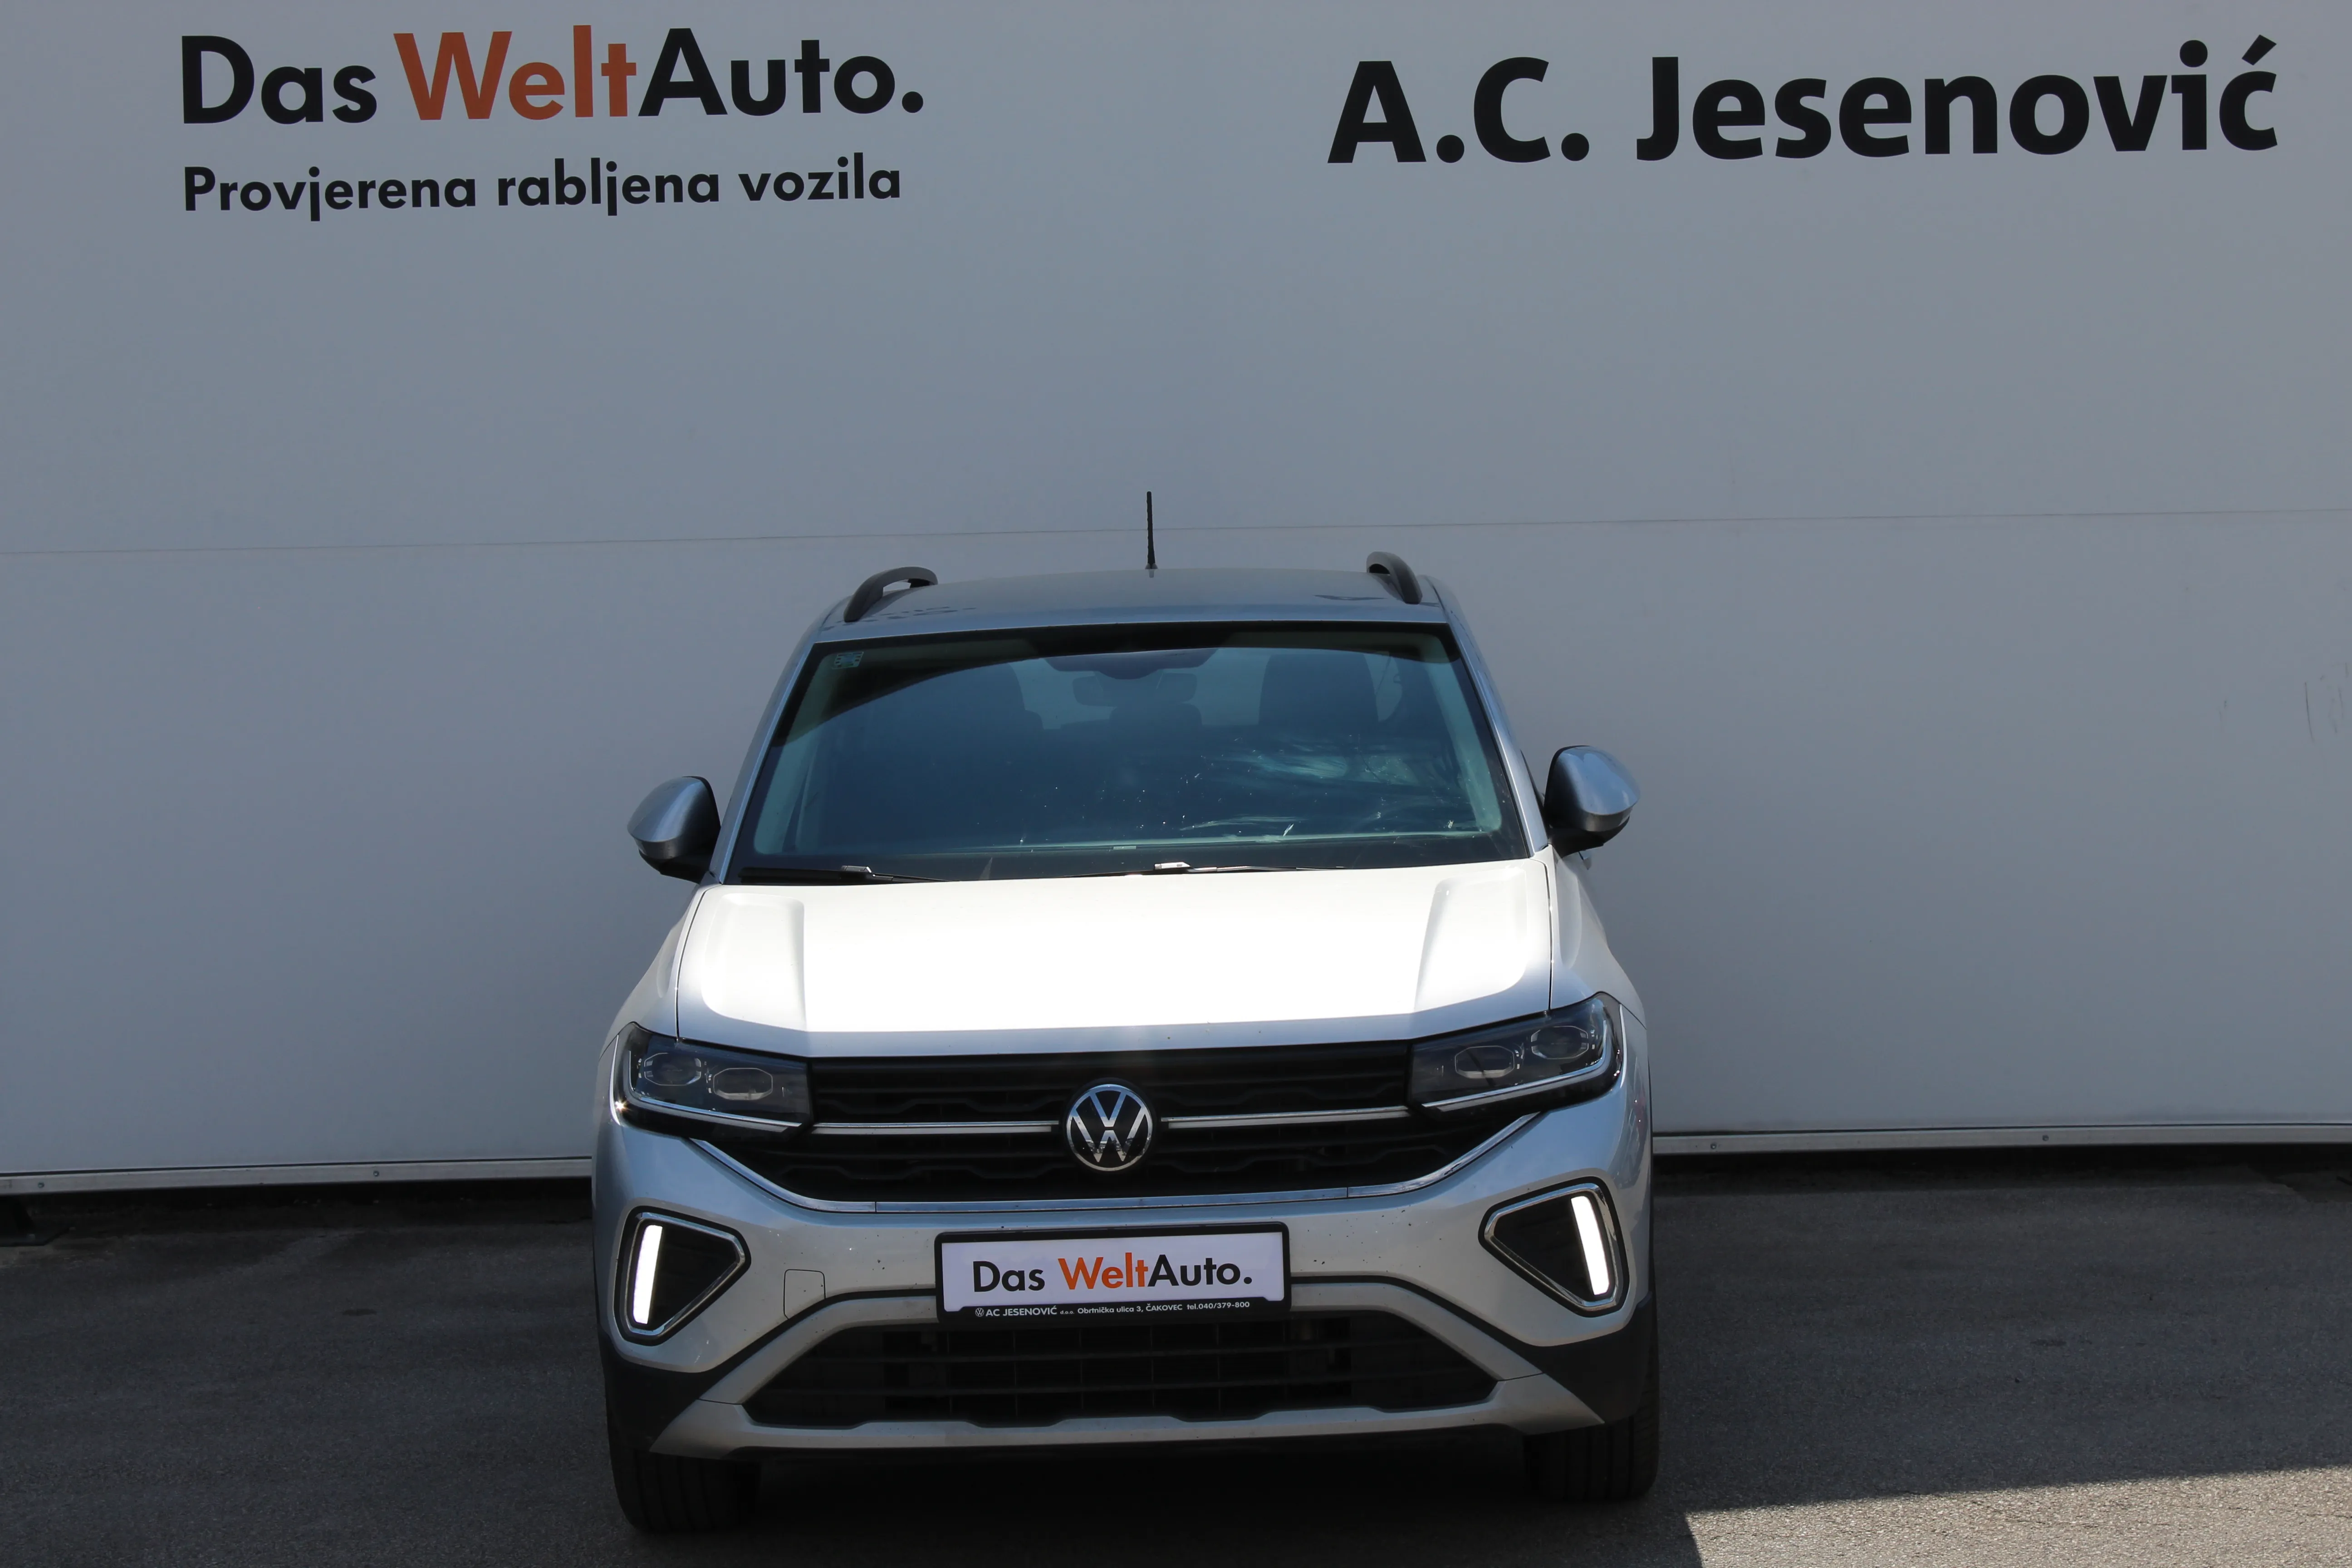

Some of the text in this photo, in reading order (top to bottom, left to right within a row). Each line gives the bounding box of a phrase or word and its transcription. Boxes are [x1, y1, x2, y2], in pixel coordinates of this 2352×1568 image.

[181, 25, 924, 125] Das WeltAuto.
[1327, 34, 2278, 164] A.C. Jesenović
[184, 152, 900, 222] Provjerena rabljena vozila
[973, 1252, 1252, 1293] Das WeltAuto.
[985, 1308, 1000, 1317] AC
[1002, 1305, 1057, 1316] JESENOVIĆ
[1186, 1301, 1250, 1310] tel.040/379-800
